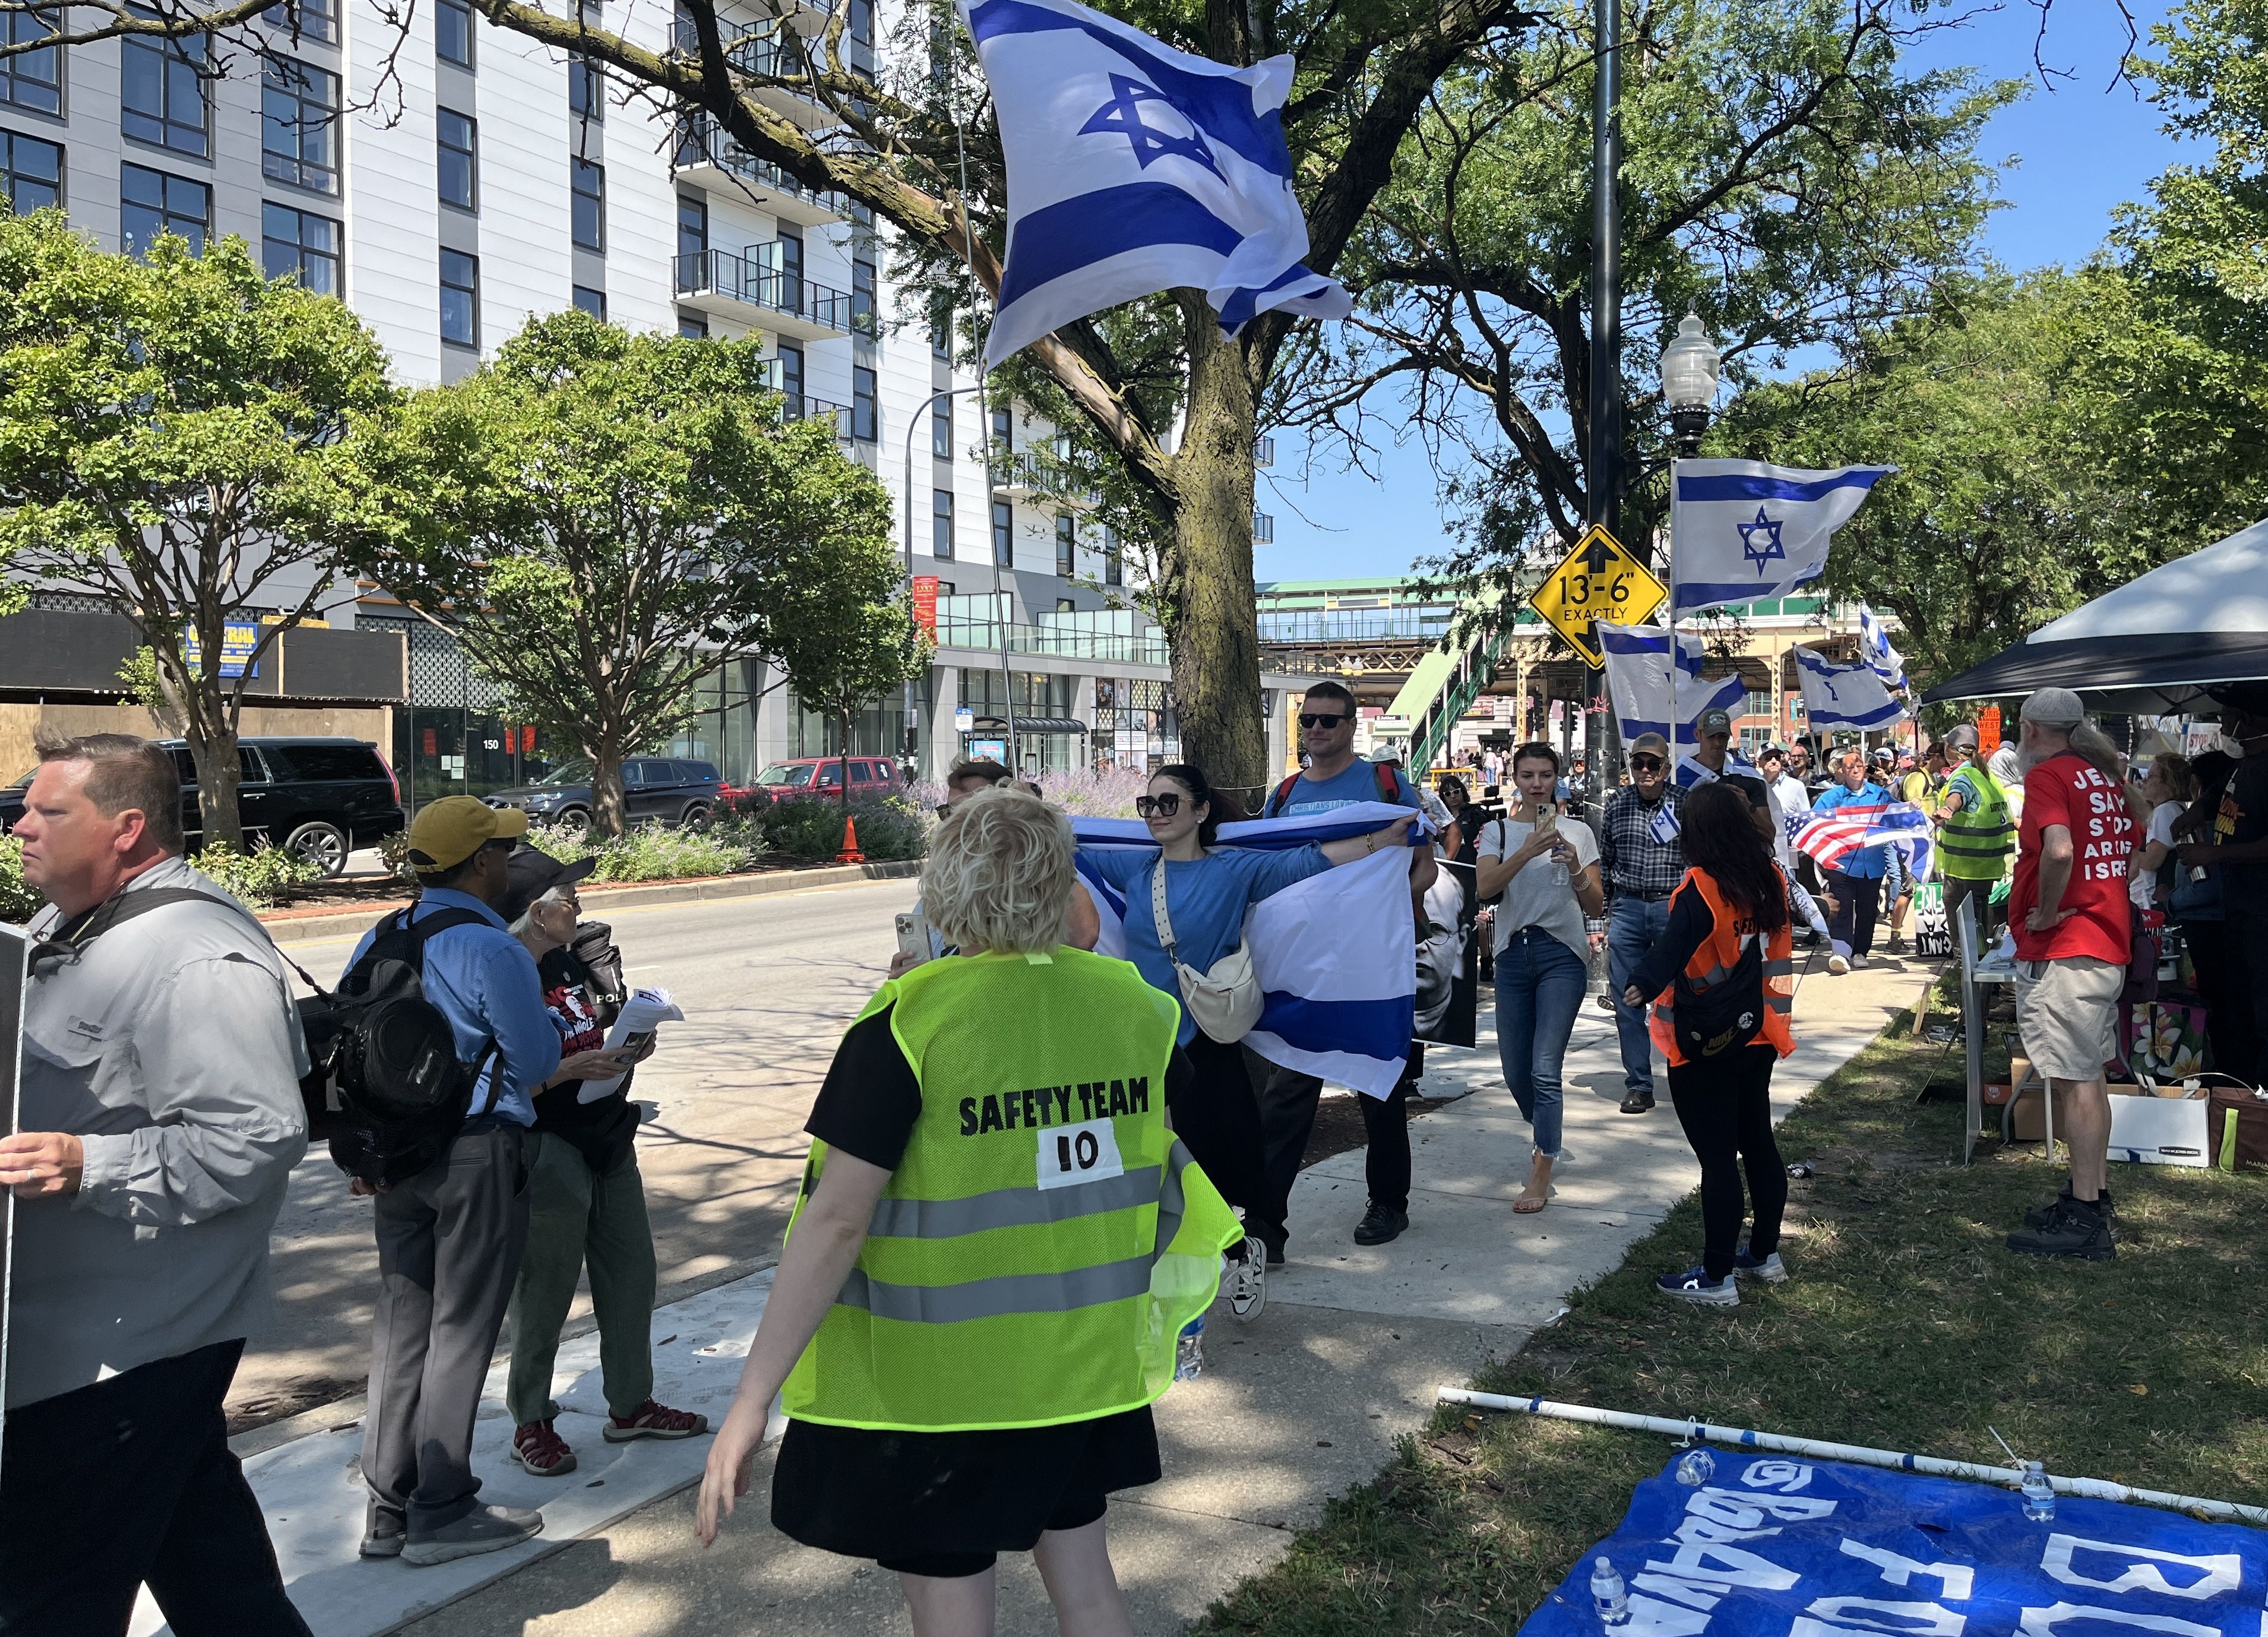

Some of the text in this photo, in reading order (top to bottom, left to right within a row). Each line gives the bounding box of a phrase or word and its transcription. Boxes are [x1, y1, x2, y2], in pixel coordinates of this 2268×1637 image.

[1564, 608, 1628, 621] EXACTLY
[483, 740, 499, 750] 150
[2190, 734, 2209, 747] STOP
[1291, 802, 1330, 813] CHRISTIANS
[2089, 792, 2125, 814] SAY
[2089, 816, 2132, 837] SOP
[574, 1017, 594, 1035] WHOLE
[1708, 1027, 1734, 1047] NIKE
[959, 1076, 1149, 1137] SAFETY TEAM
[1056, 1130, 1099, 1172] 10
